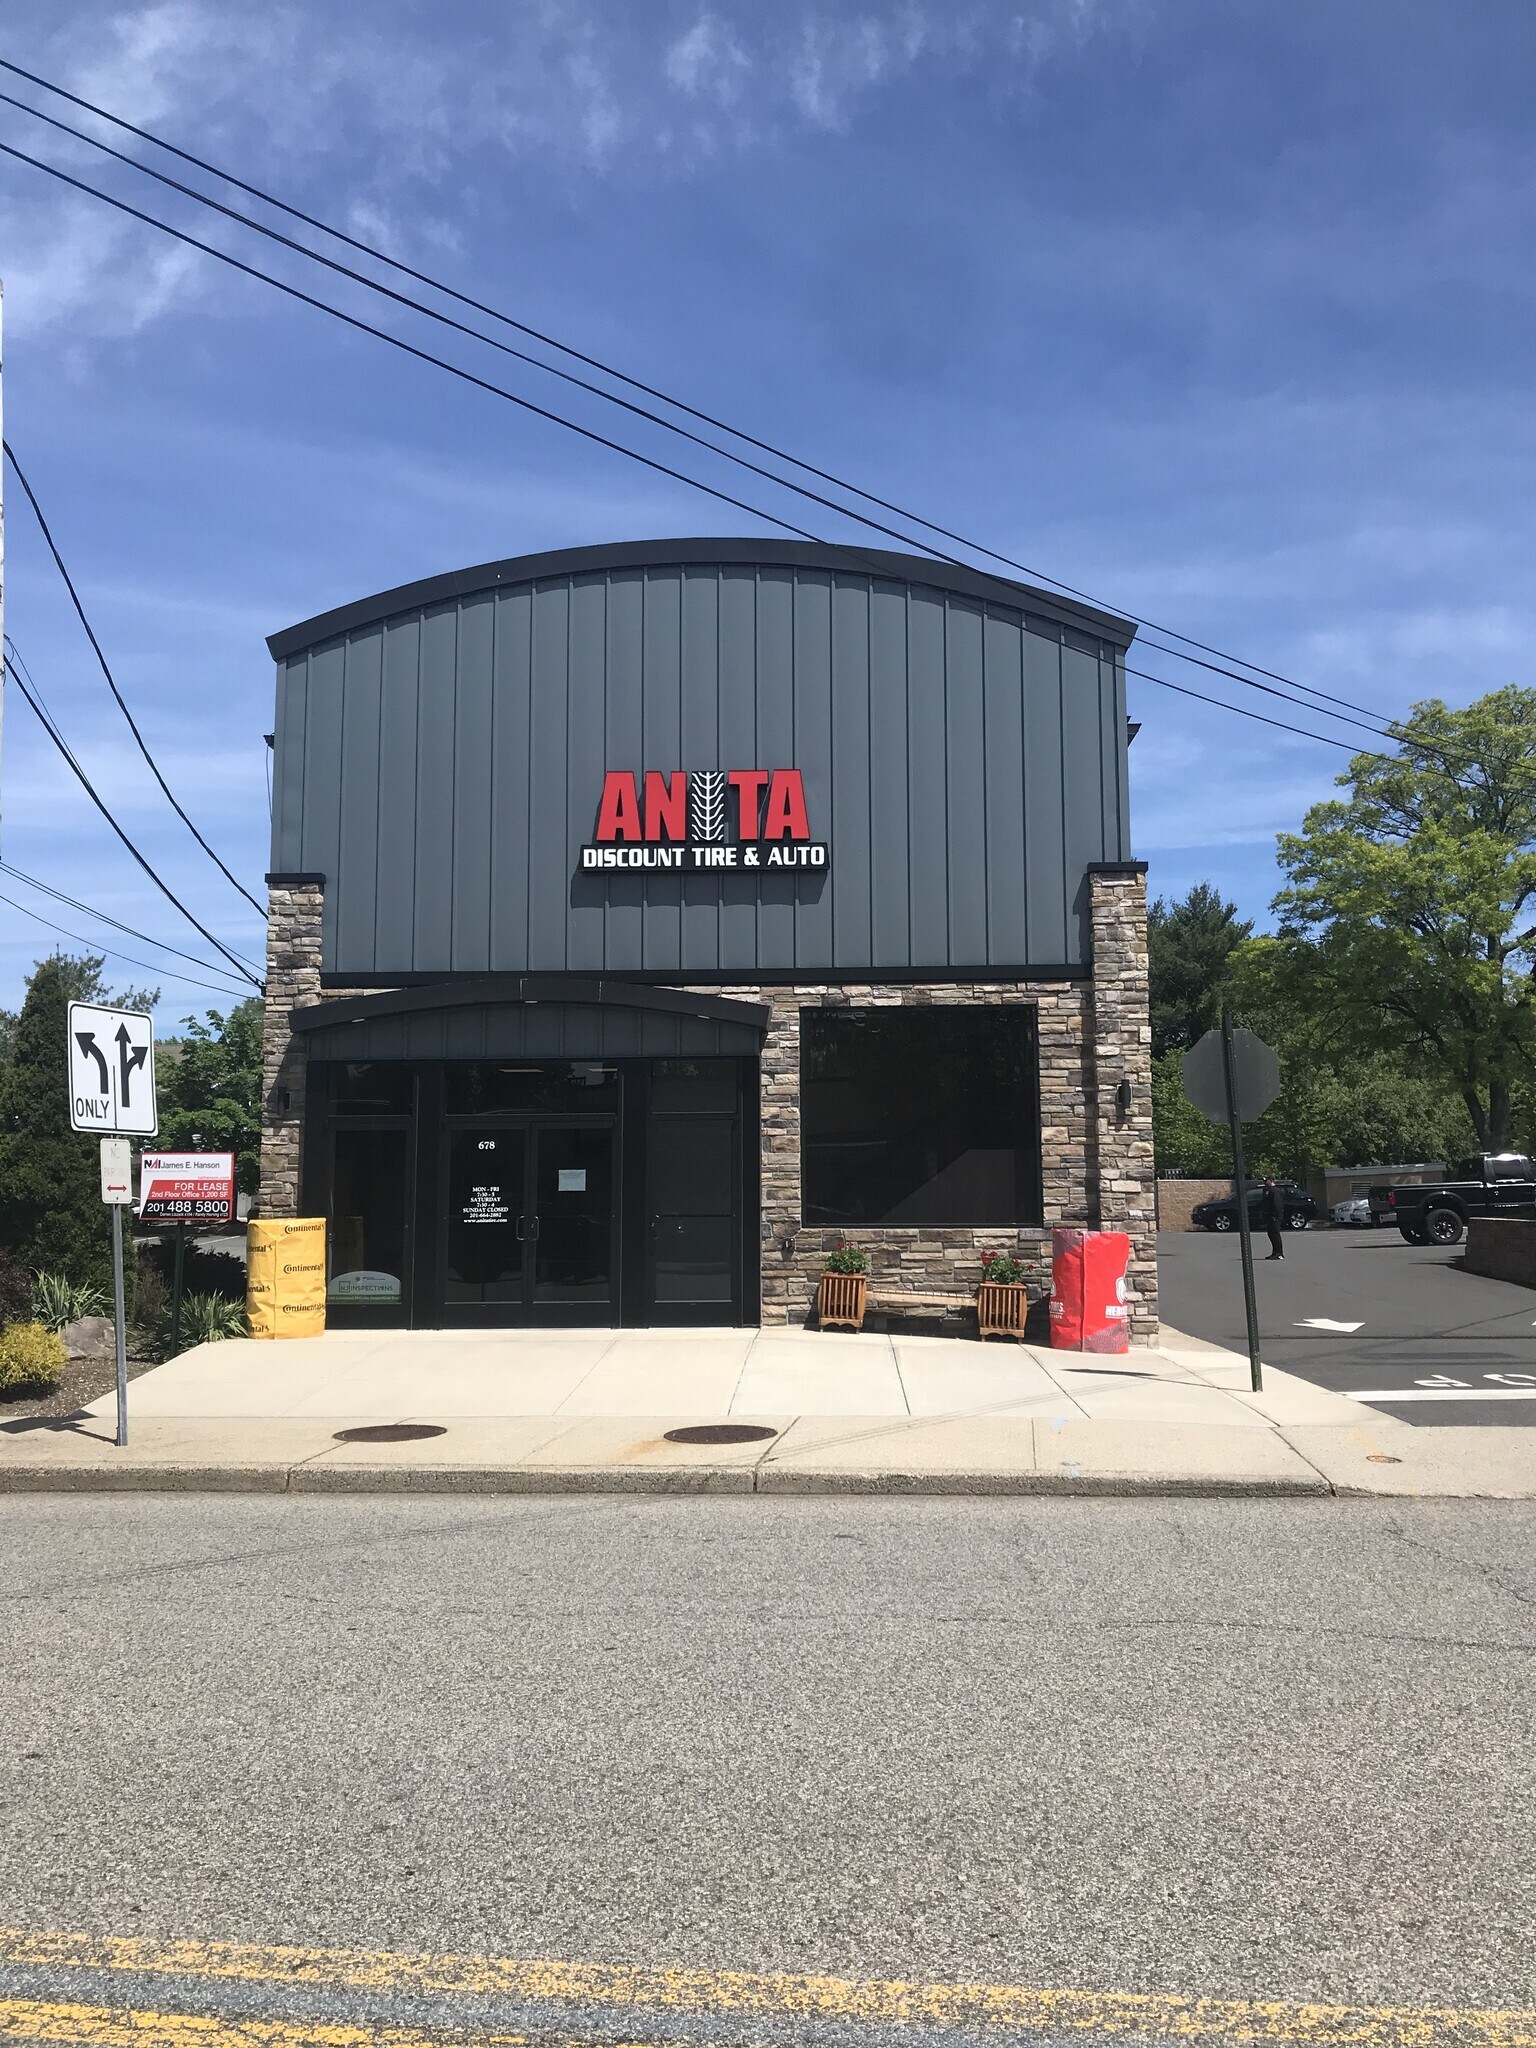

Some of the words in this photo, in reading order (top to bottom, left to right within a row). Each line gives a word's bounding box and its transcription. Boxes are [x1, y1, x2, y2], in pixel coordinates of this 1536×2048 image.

[583, 848, 685, 868] DISCOUNT
[692, 847, 737, 867] TIRE
[744, 847, 760, 866] &
[767, 846, 825, 866] AUTO
[76, 1097, 110, 1119] ONLY
[478, 1140, 496, 1150] 678
[110, 1147, 121, 1159] NO
[144, 1157, 161, 1169] NAI
[161, 1161, 184, 1169] James
[174, 1182, 195, 1191] FOR
[197, 1182, 229, 1191] LEASE
[201, 1191, 218, 1199] 1,200
[147, 1203, 164, 1212] 201
[166, 1201, 192, 1213] 488
[195, 1200, 229, 1213] 5800
